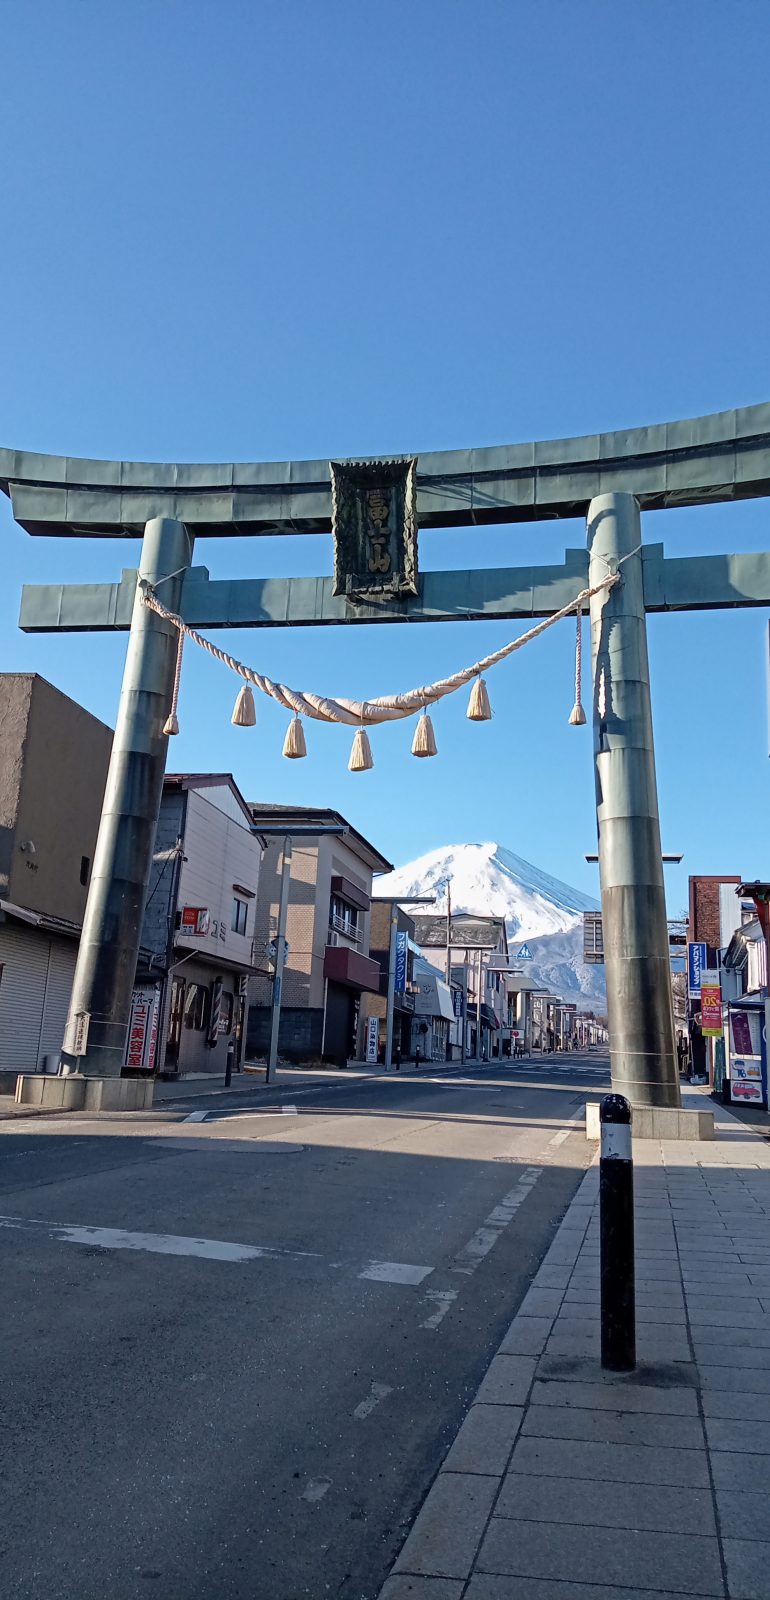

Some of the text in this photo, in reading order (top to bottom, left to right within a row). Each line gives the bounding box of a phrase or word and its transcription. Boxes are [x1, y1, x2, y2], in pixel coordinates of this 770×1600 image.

[366, 488, 391, 574] 富士山
[397, 933, 405, 989] フガクタクシー
[128, 1005, 147, 1067] ユミ美容室
